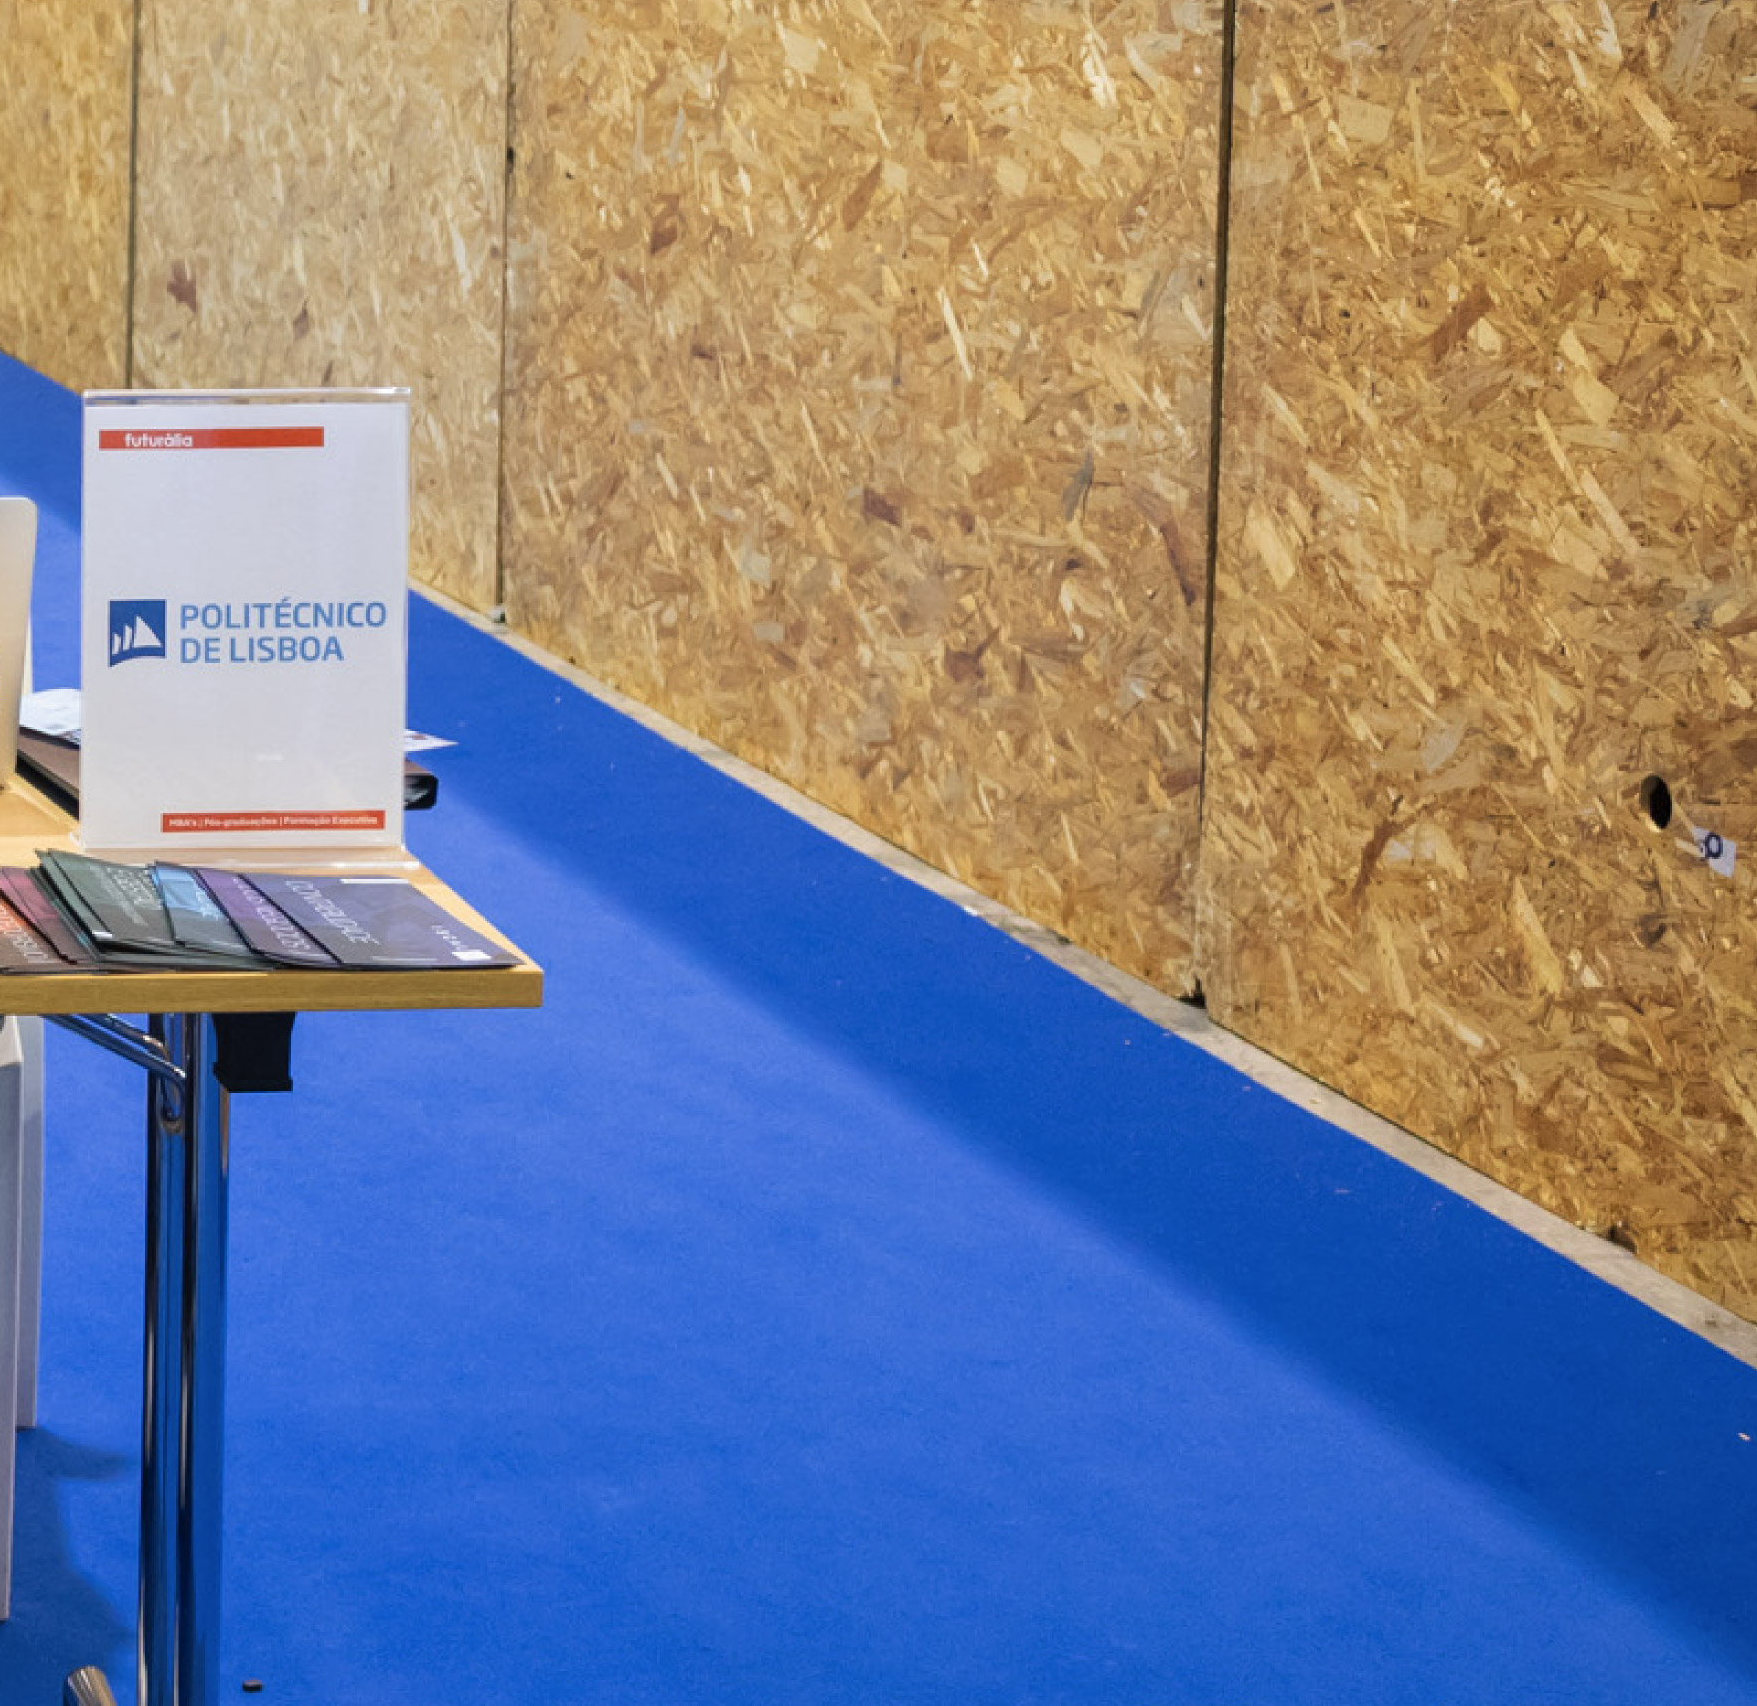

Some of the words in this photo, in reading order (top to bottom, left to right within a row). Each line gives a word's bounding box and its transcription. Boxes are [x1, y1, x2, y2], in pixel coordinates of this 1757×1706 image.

[124, 432, 193, 448] futurália
[180, 597, 387, 630] POLITÉCNICO
[180, 637, 222, 663] DE
[230, 636, 345, 662] LISBOA
